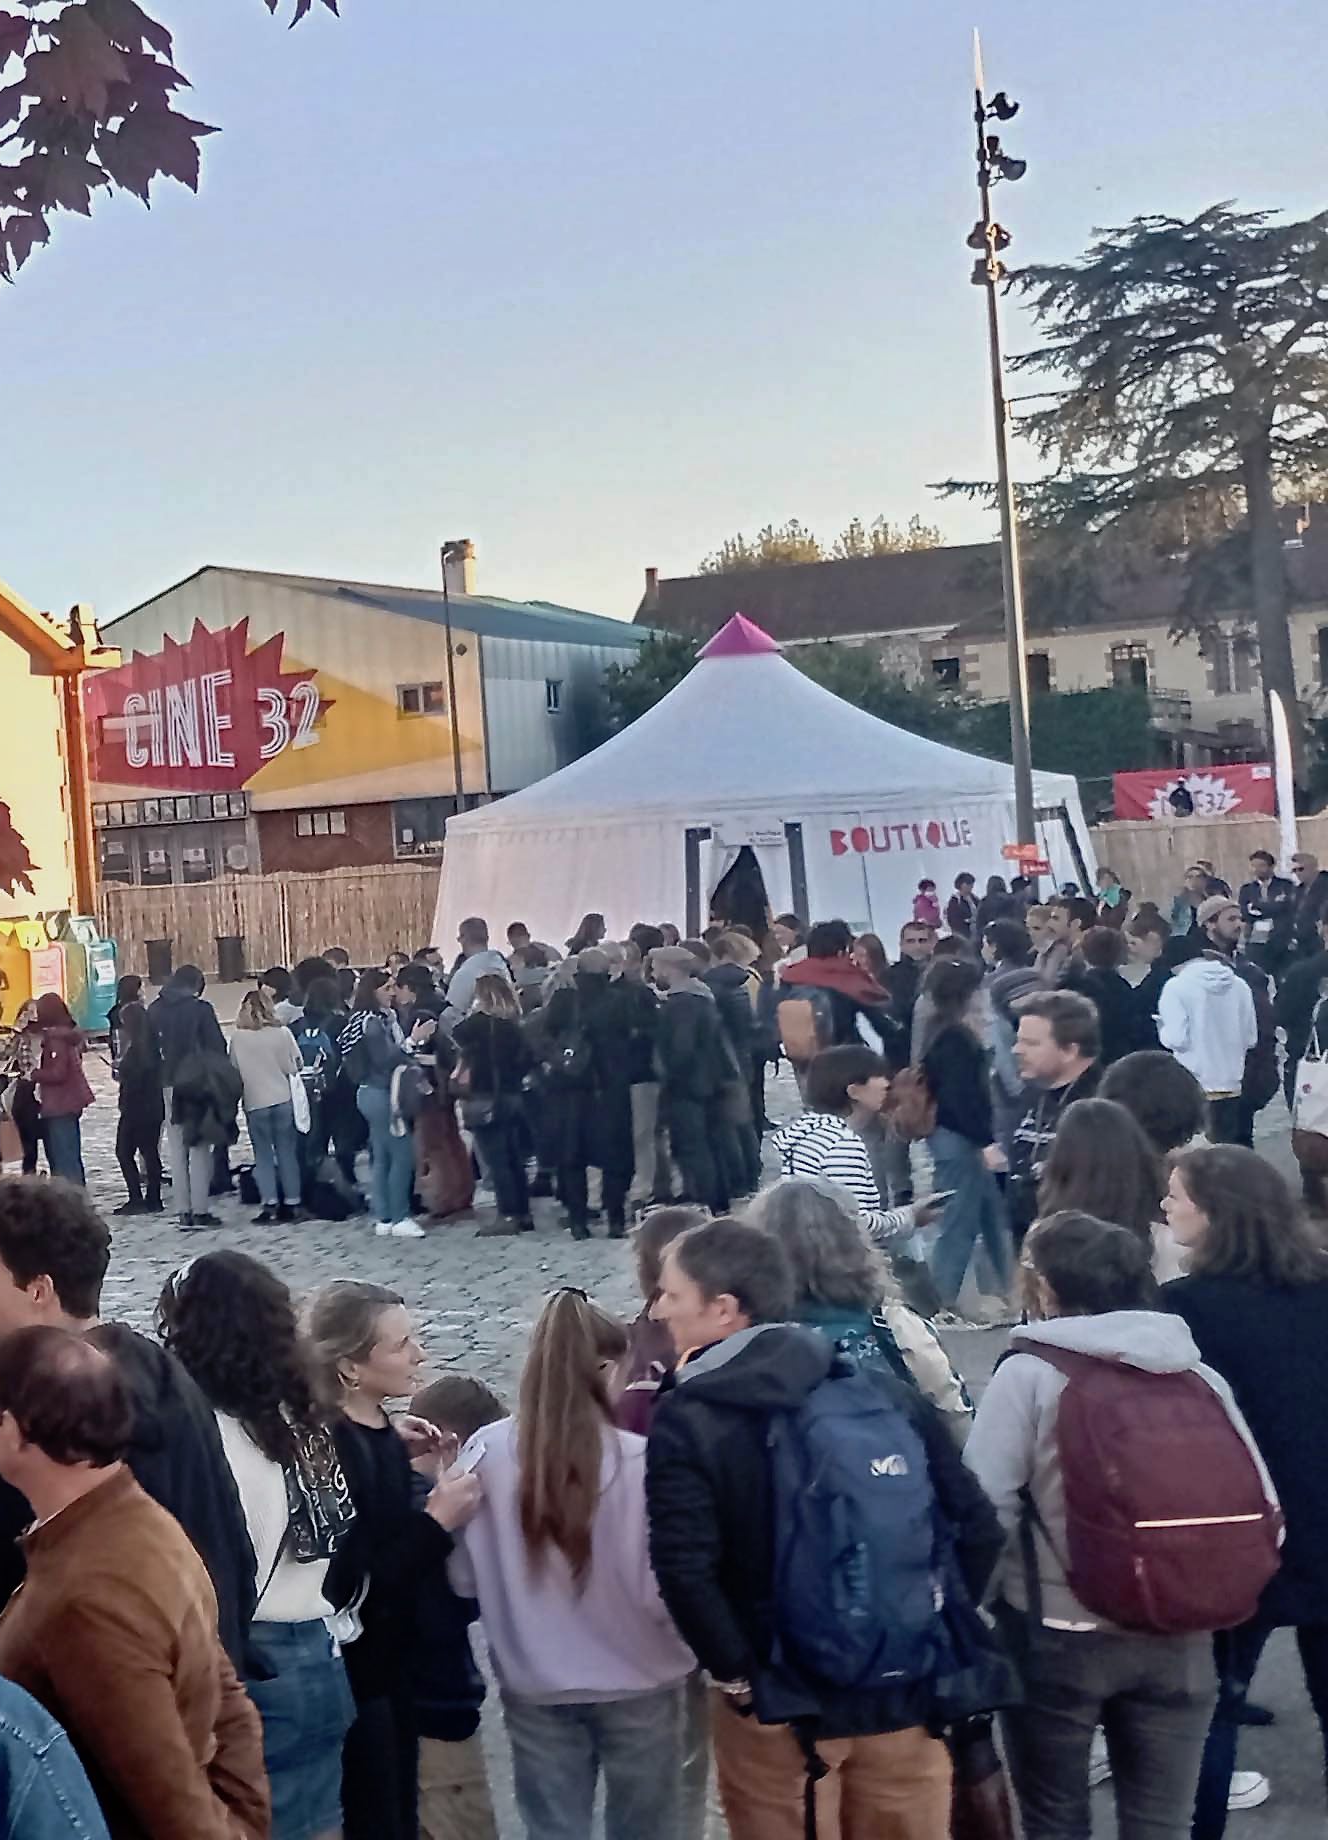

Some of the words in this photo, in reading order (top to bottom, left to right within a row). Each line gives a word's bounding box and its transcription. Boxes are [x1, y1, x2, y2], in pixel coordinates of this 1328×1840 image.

[123, 668, 236, 769] CINE
[255, 680, 321, 760] 32
[829, 818, 973, 857] BOUTIQUE
